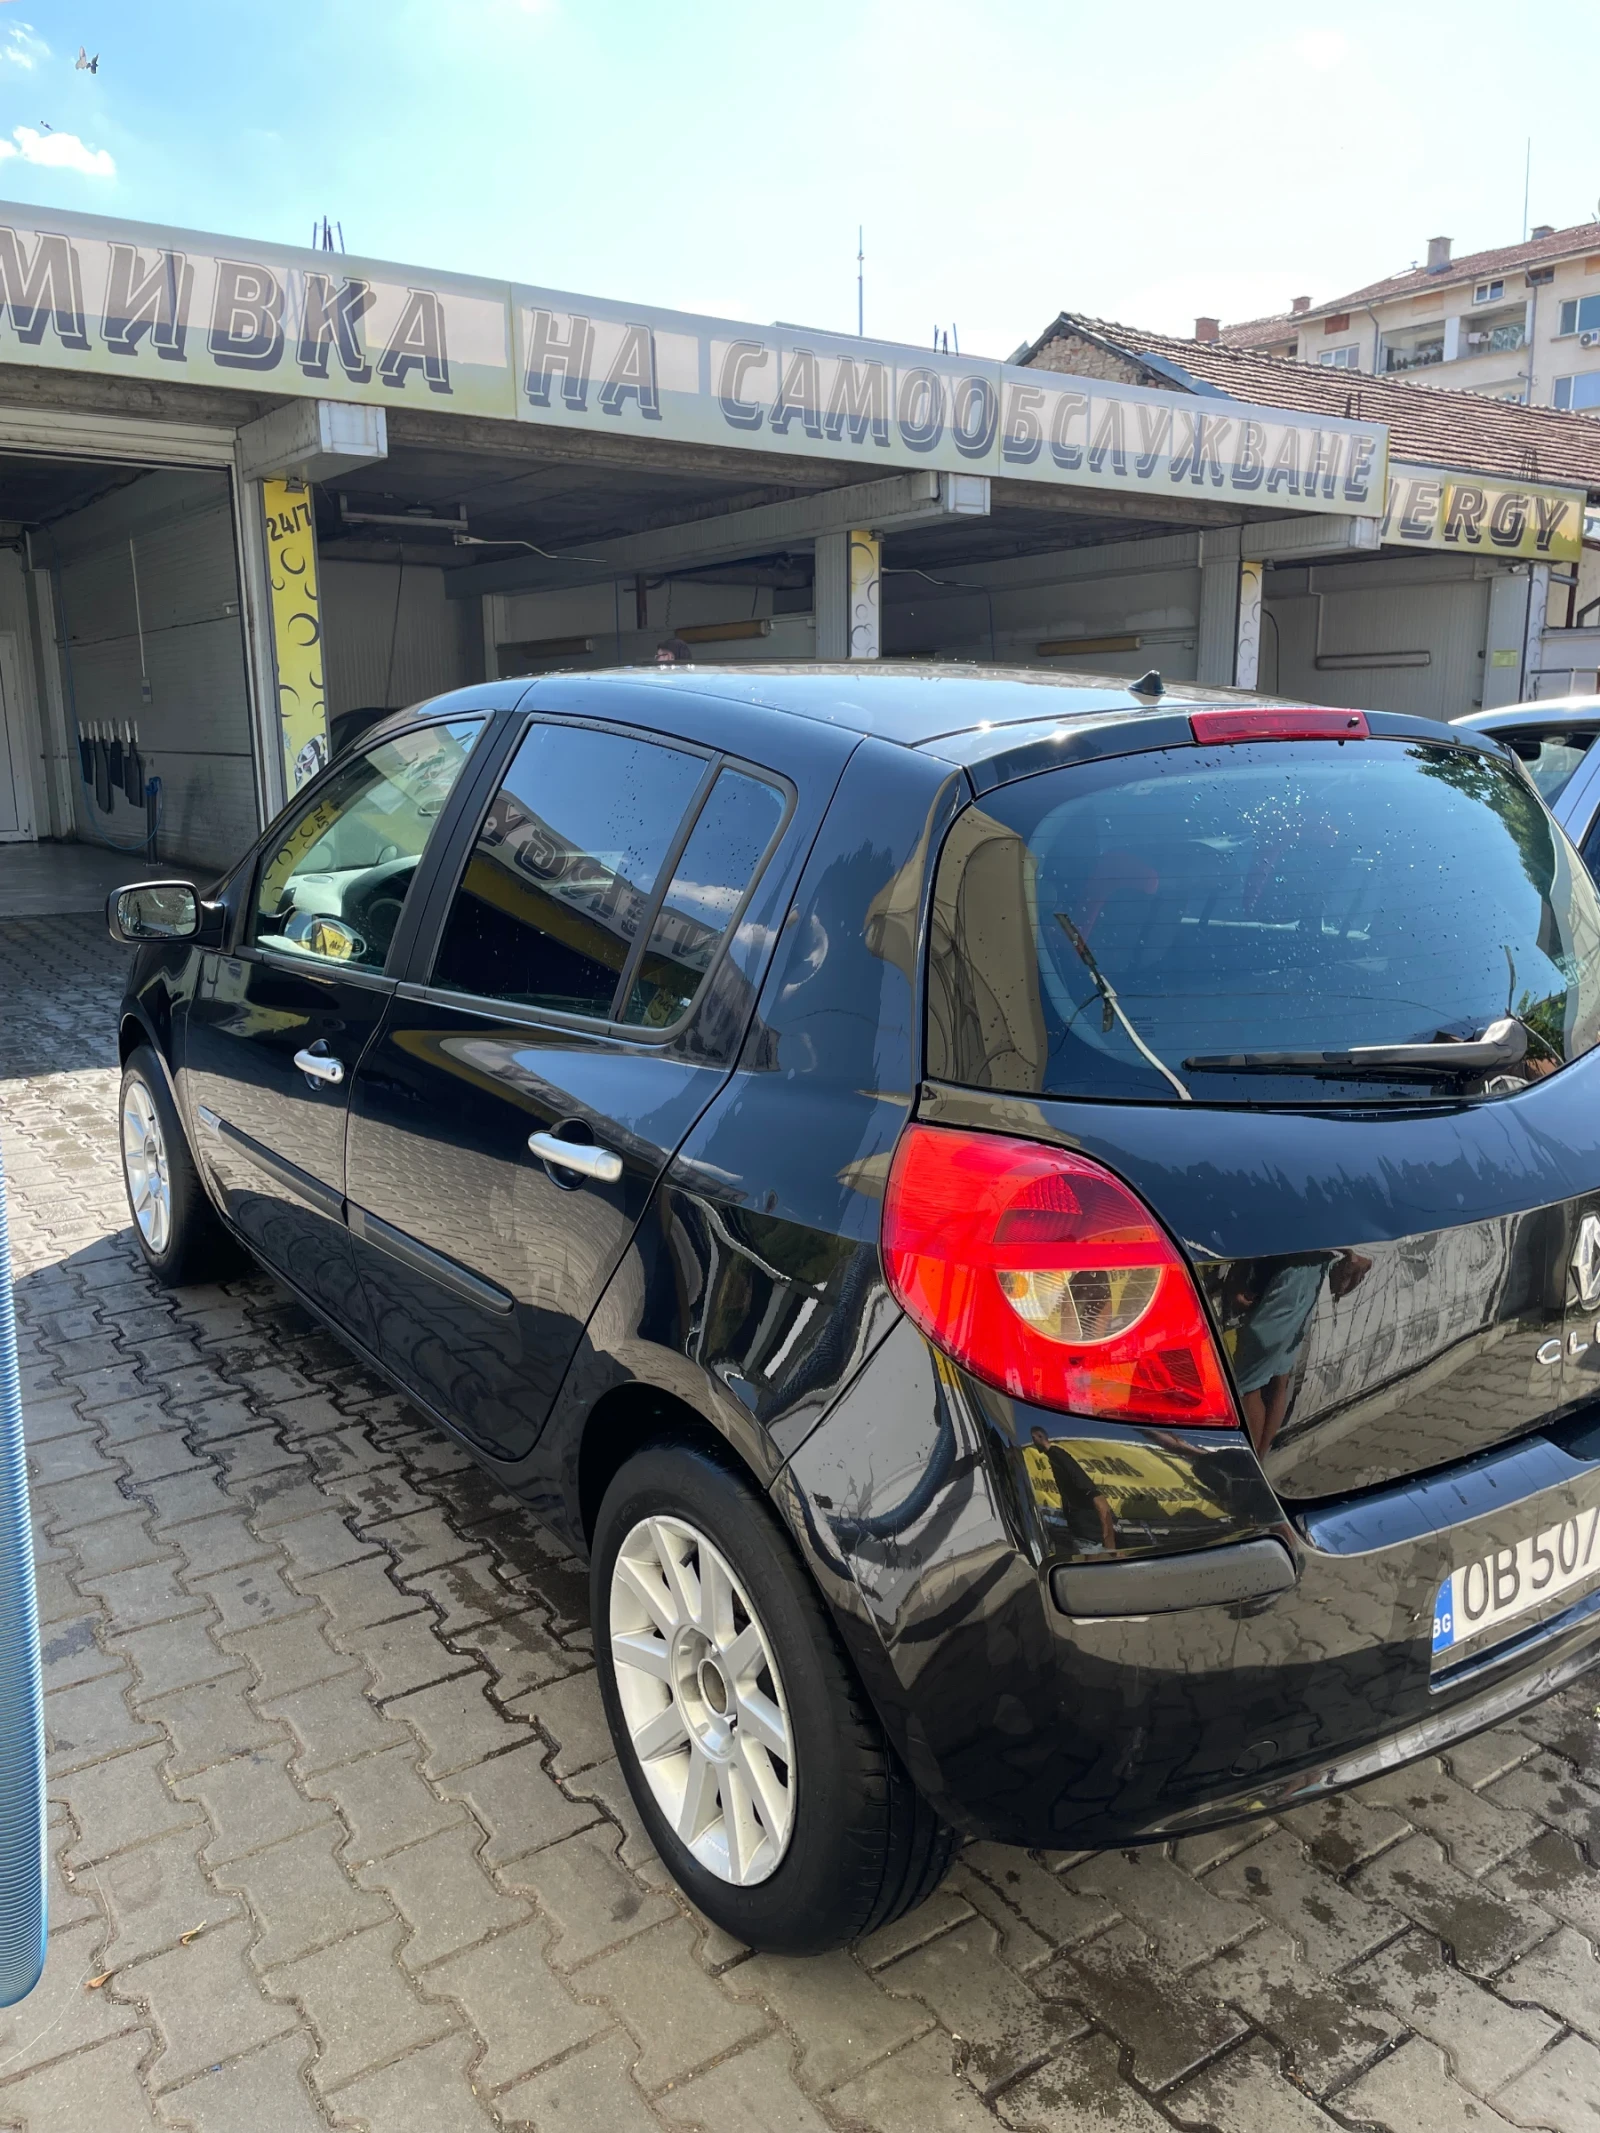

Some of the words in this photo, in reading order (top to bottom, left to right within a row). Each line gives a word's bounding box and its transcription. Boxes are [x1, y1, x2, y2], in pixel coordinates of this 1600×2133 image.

[524, 307, 662, 421] НА
[717, 339, 1376, 503] САМООБСЛУЖВАНЕ
[266, 502, 312, 541] 24/7
[1432, 1613, 1452, 1639] BG
